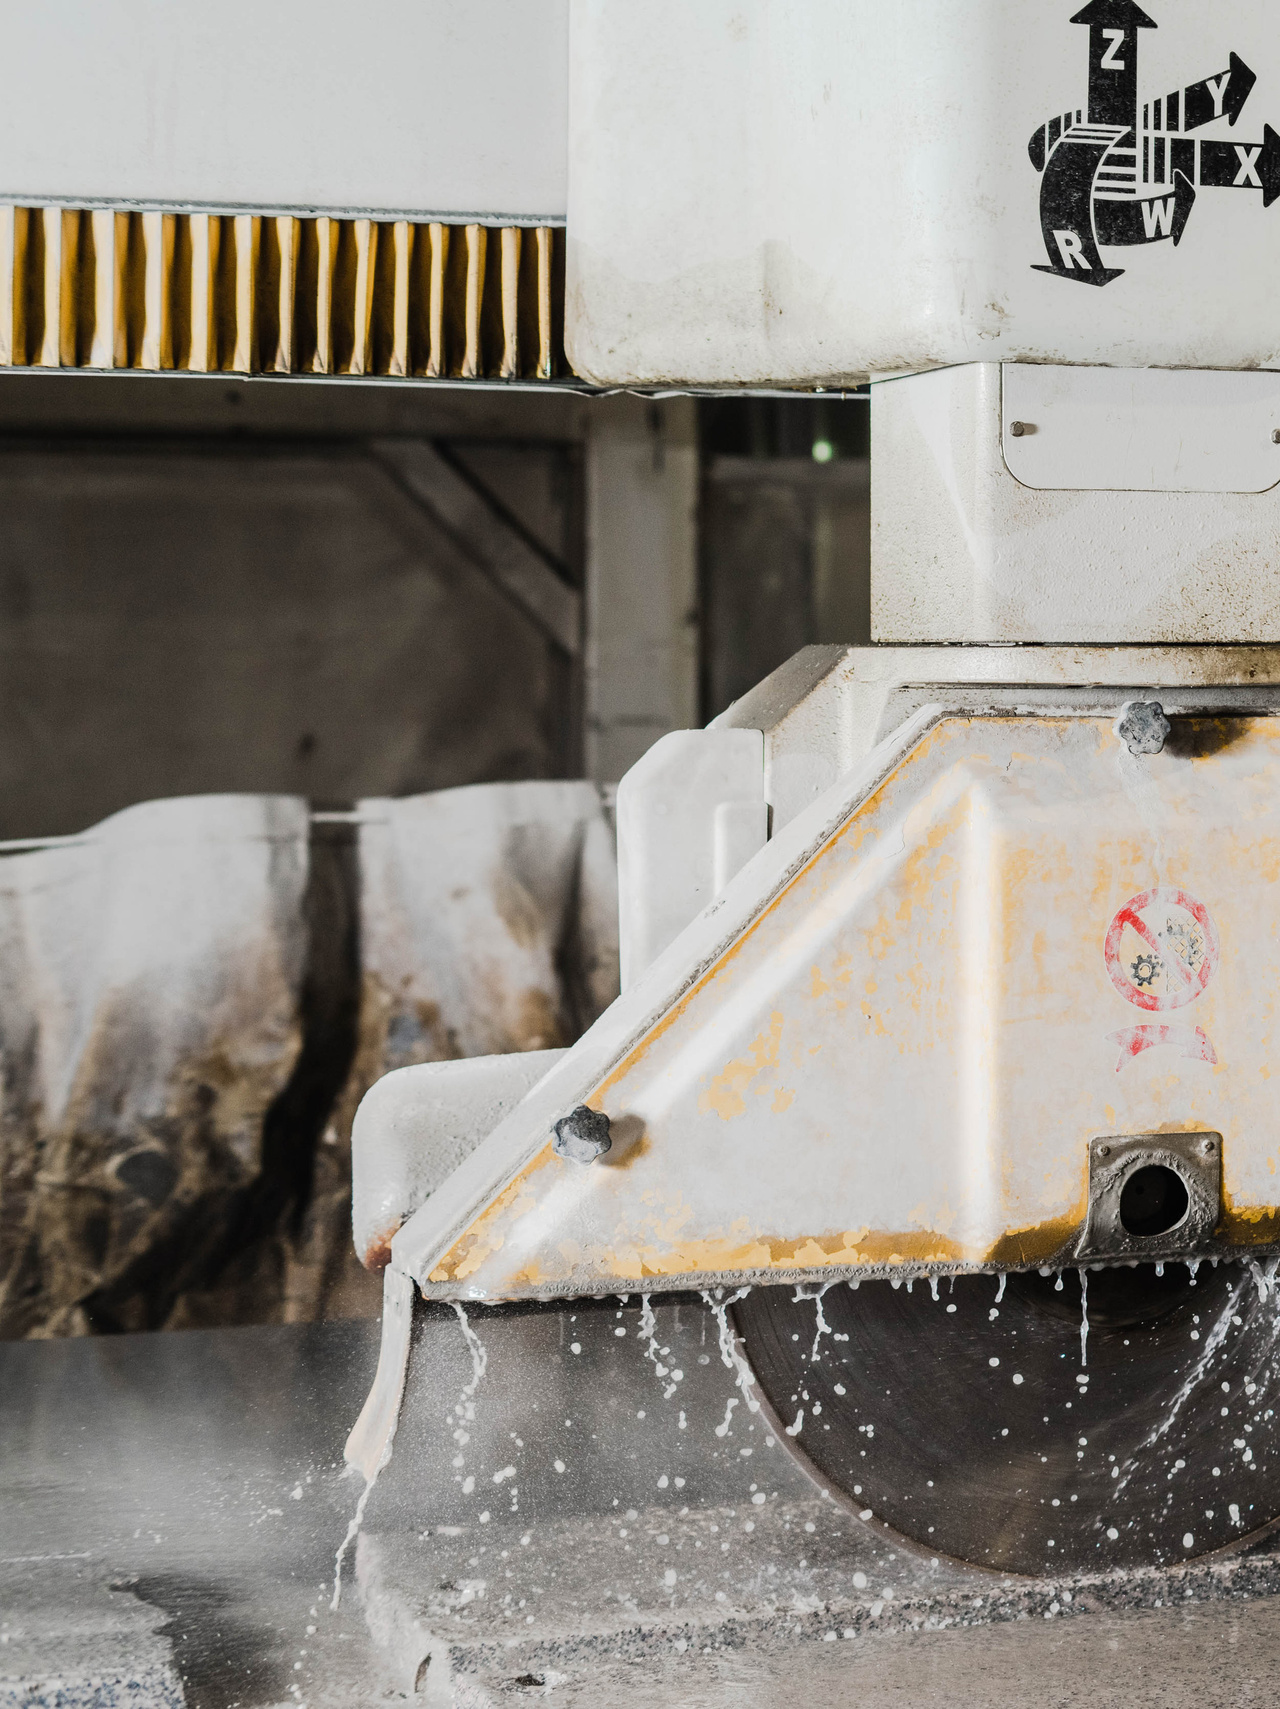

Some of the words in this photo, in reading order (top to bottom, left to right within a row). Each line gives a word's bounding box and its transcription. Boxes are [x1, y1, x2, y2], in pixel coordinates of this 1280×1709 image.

[1101, 28, 1125, 70] Z
[1205, 71, 1232, 117] Y
[1232, 145, 1263, 187] X
[1141, 197, 1176, 238] W
[1052, 229, 1093, 270] R
